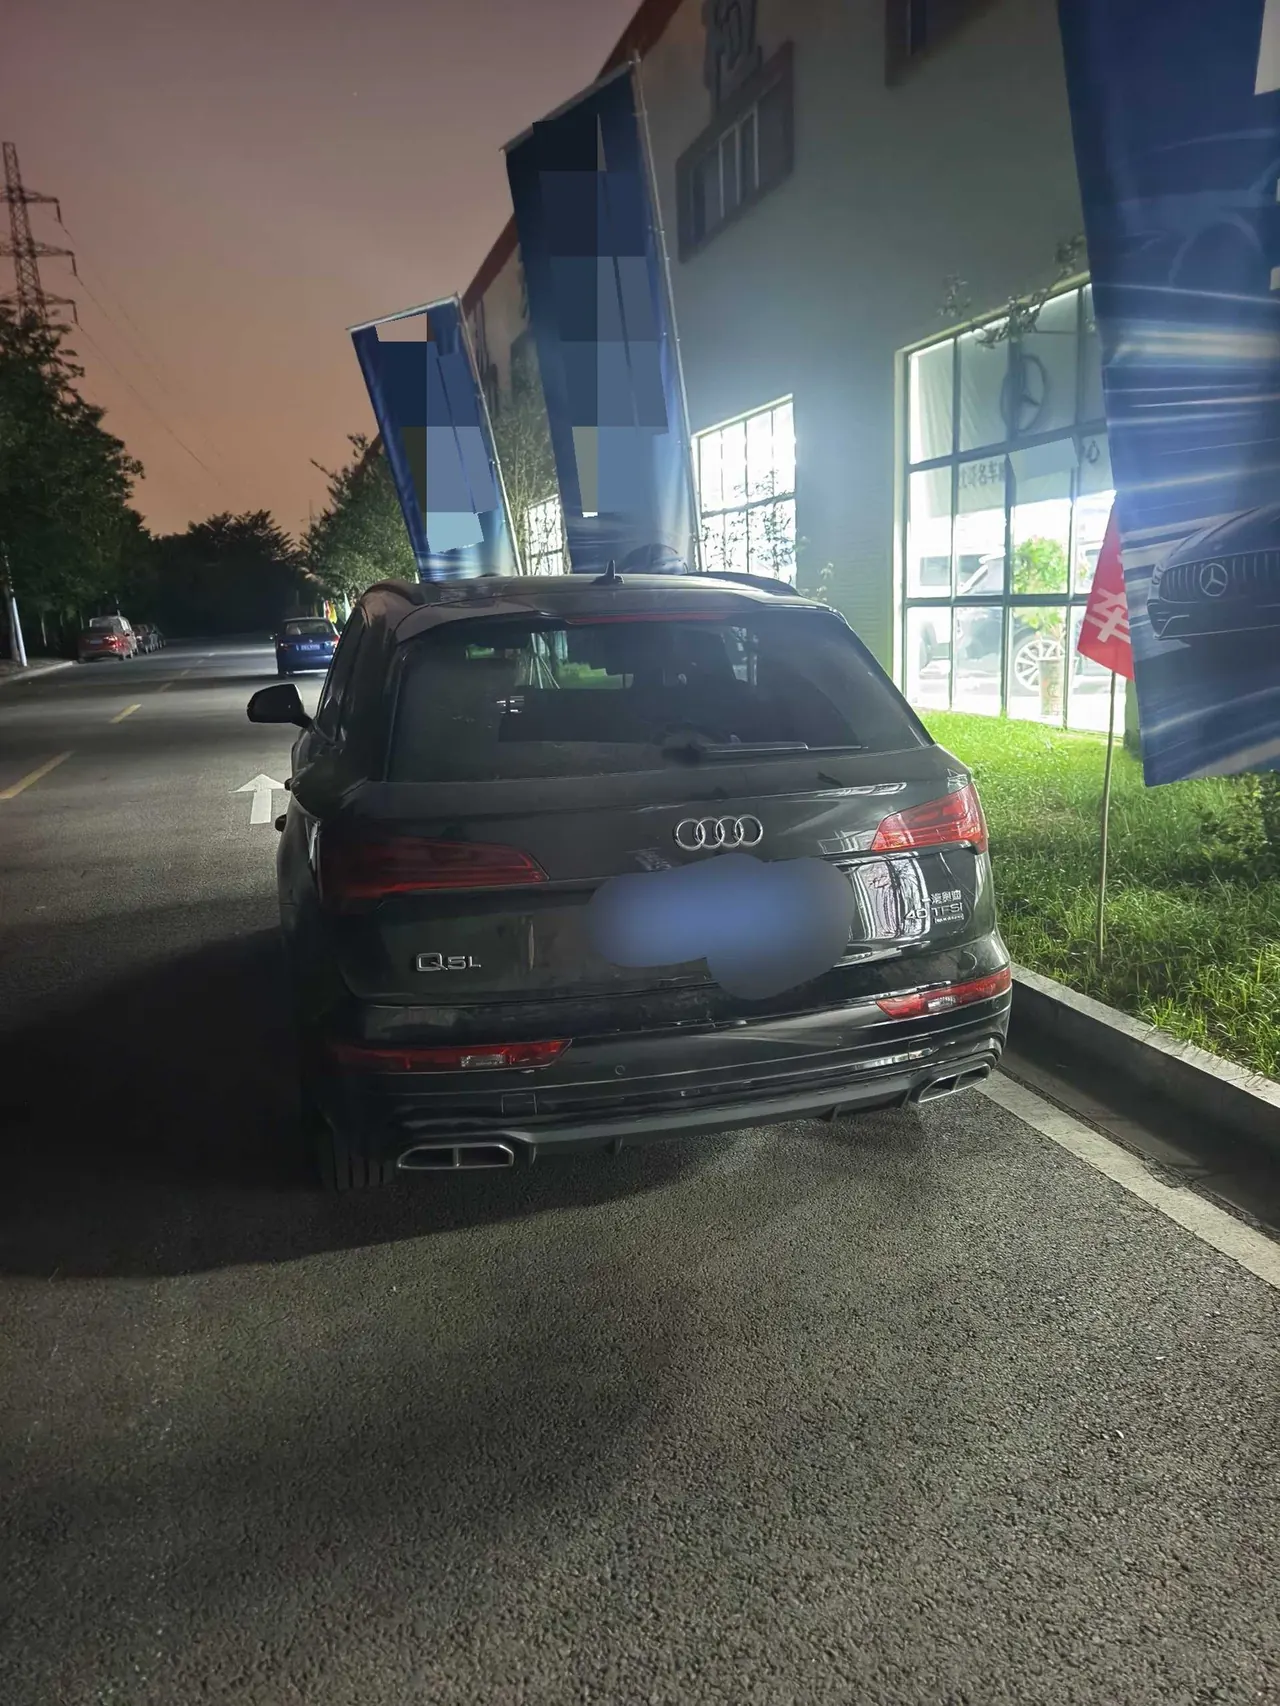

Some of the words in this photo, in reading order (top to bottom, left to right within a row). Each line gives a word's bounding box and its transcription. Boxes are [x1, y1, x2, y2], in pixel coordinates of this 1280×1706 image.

[905, 908, 927, 919] 40
[931, 902, 963, 916] TFSI
[416, 952, 481, 971] Q5L
